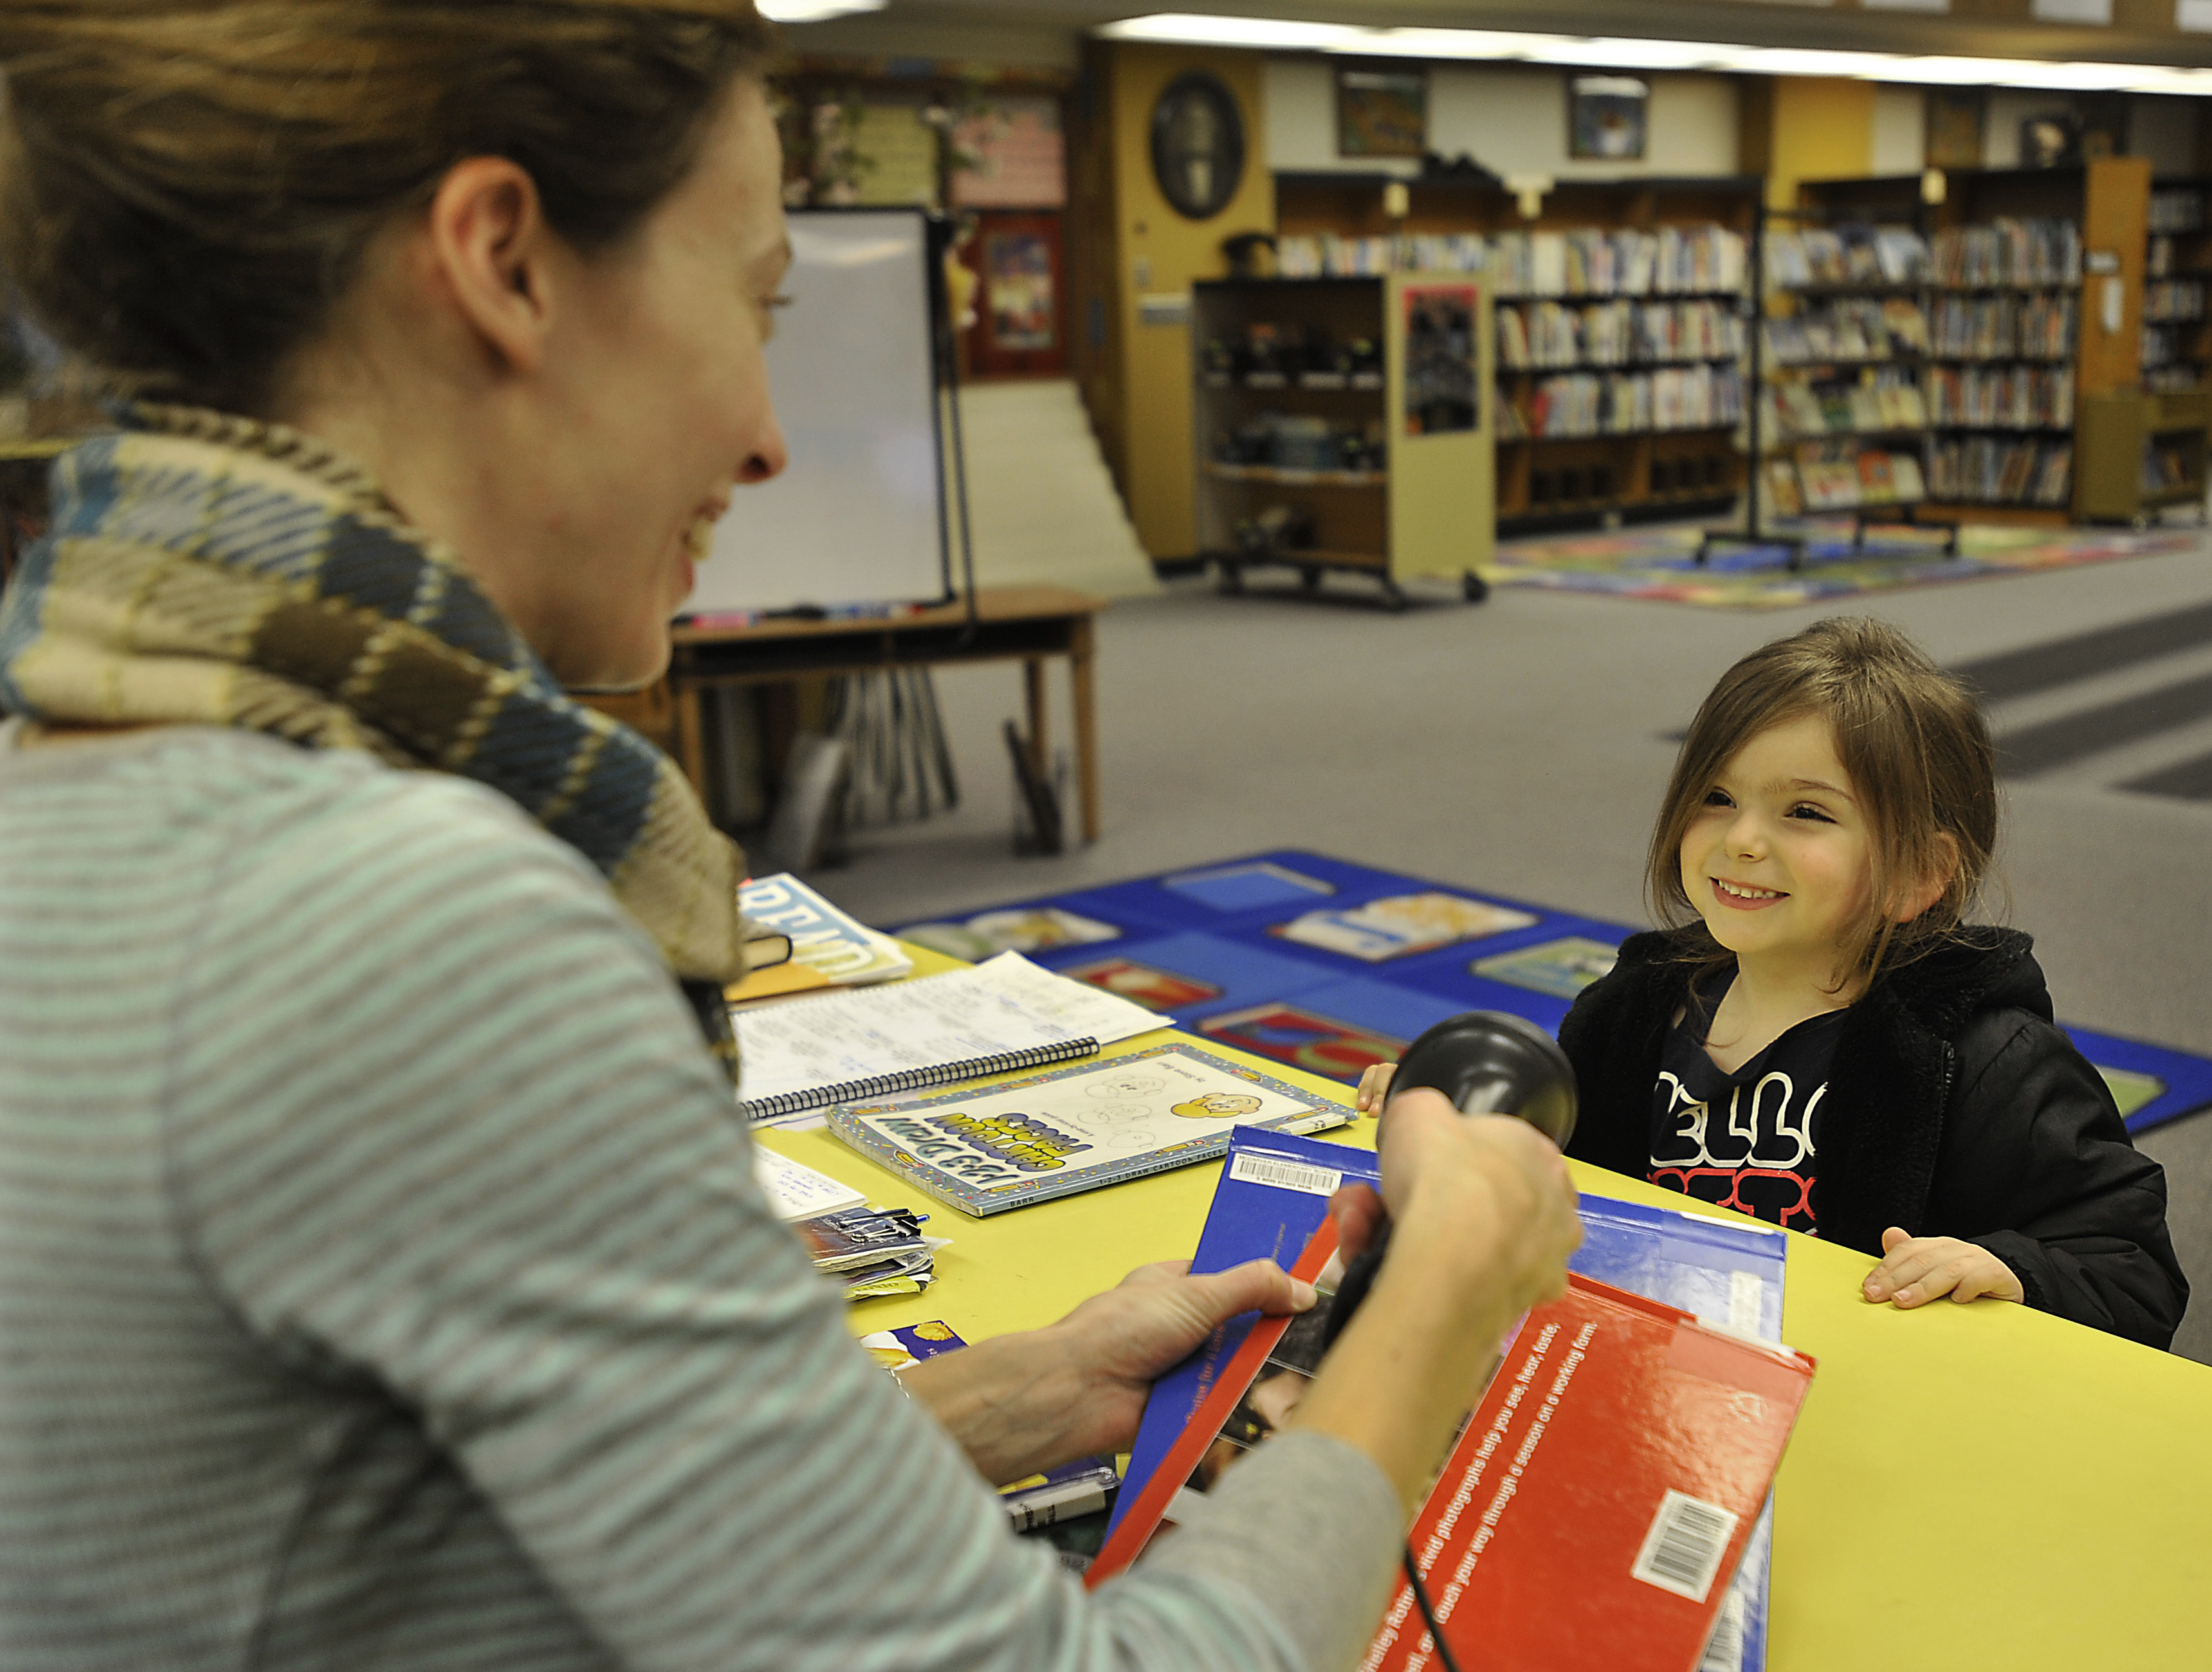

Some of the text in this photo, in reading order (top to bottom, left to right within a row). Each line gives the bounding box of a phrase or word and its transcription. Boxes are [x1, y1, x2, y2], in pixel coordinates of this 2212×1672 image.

[875, 1117, 965, 1159] Draw
[924, 1112, 1066, 1172] CARTOON
[979, 1113, 1095, 1157] FACES
[1010, 1197, 1034, 1207] BARR
[1125, 1166, 1151, 1179] DRAW
[1153, 1157, 1194, 1173] CARTOON
[1196, 1149, 1223, 1162] FACES
[1532, 1322, 1561, 1354] taste,
[1571, 1321, 1598, 1351] farm.
[1515, 1354, 1544, 1384] hear,
[1550, 1348, 1585, 1395] working
[1504, 1383, 1528, 1410] see,
[1537, 1402, 1555, 1424] on
[1546, 1393, 1560, 1406] a
[1492, 1406, 1513, 1433] you
[1474, 1430, 1502, 1460] help
[1513, 1420, 1546, 1467] season
[1508, 1463, 1524, 1477] a
[1435, 1456, 1486, 1540] photographs
[1481, 1474, 1518, 1527] through
[1418, 1534, 1445, 1570] vivid
[1469, 1523, 1494, 1554] way
[1453, 1550, 1479, 1586] your
[1433, 1581, 1463, 1624] touch
